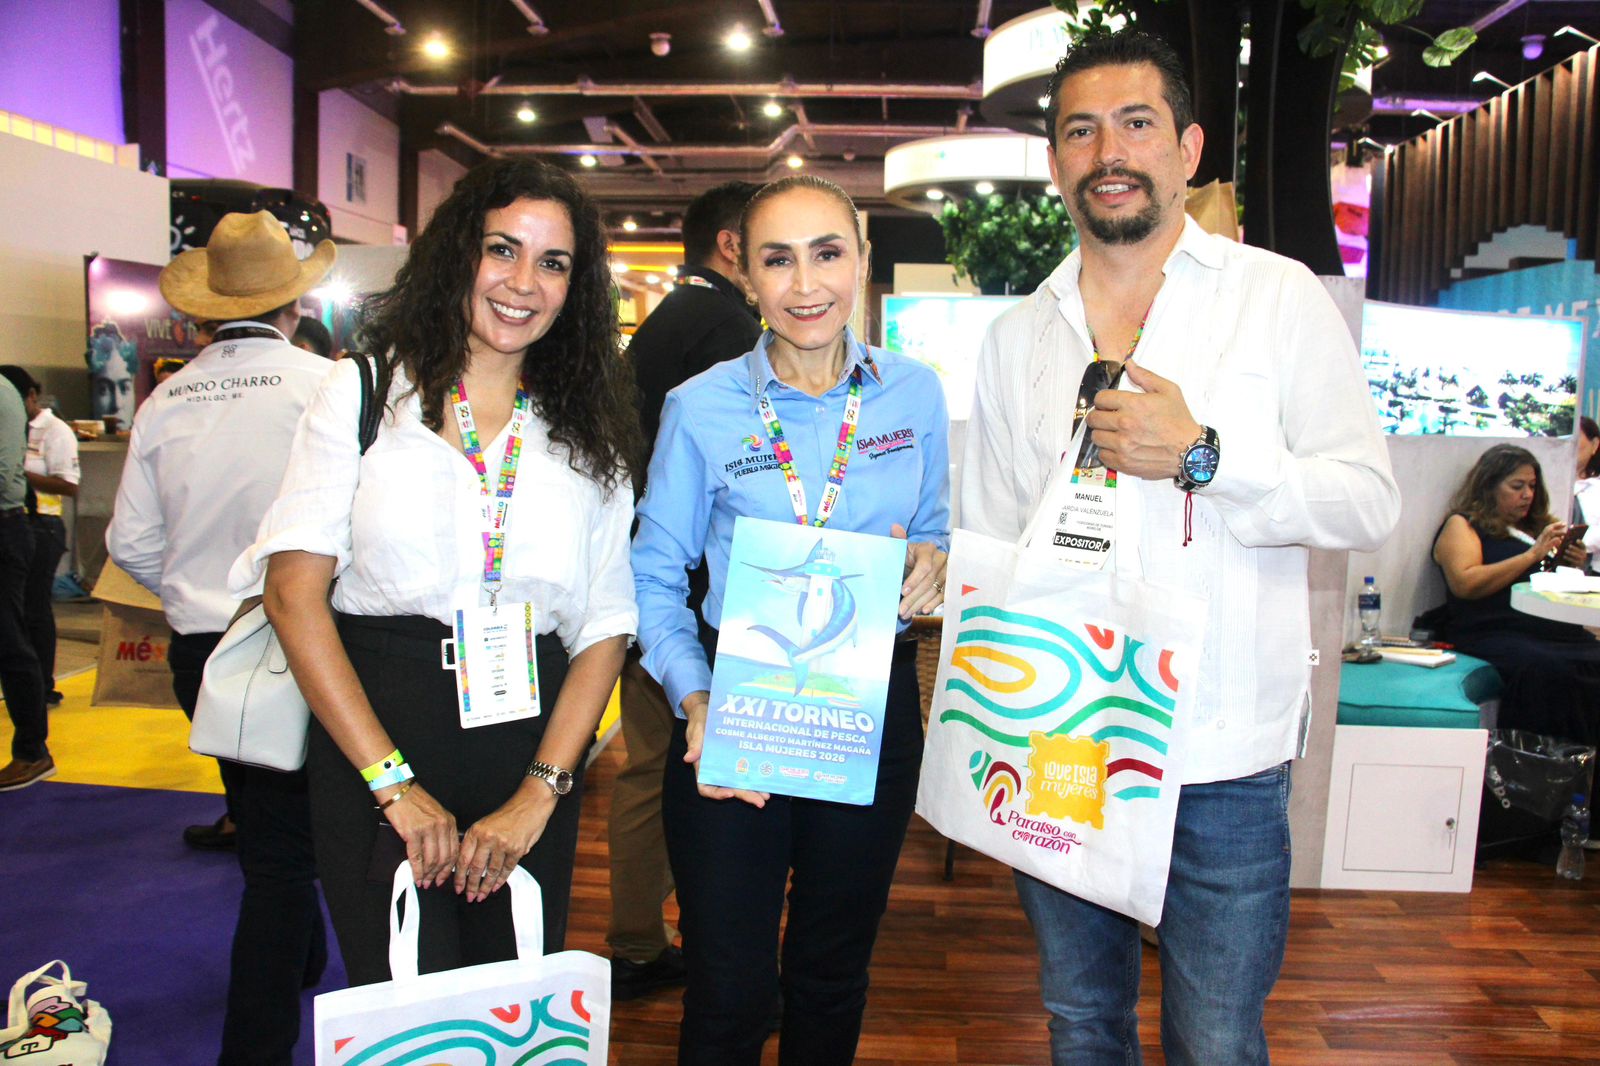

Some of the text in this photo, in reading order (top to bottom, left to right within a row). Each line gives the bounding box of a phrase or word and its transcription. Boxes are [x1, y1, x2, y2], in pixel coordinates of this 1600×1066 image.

[195, 14, 256, 172] Hertz
[145, 318, 173, 340] VIVE
[167, 375, 282, 398] MUNDO CHARRO
[734, 465, 759, 479] PUEBLO
[1075, 492, 1103, 503] MANUEL
[1080, 507, 1114, 517] VALENZUELA
[1054, 535, 1102, 551] EXPOSITOR
[717, 694, 875, 733] XXI TORNEO
[723, 716, 867, 744] INTERNACIONAL DE PESCA
[715, 727, 871, 756] COSME ALBERTO MARTÍNEZ MAGAÑA
[739, 740, 846, 763] ISLA MUJERES 2026
[1063, 831, 1077, 839] con
